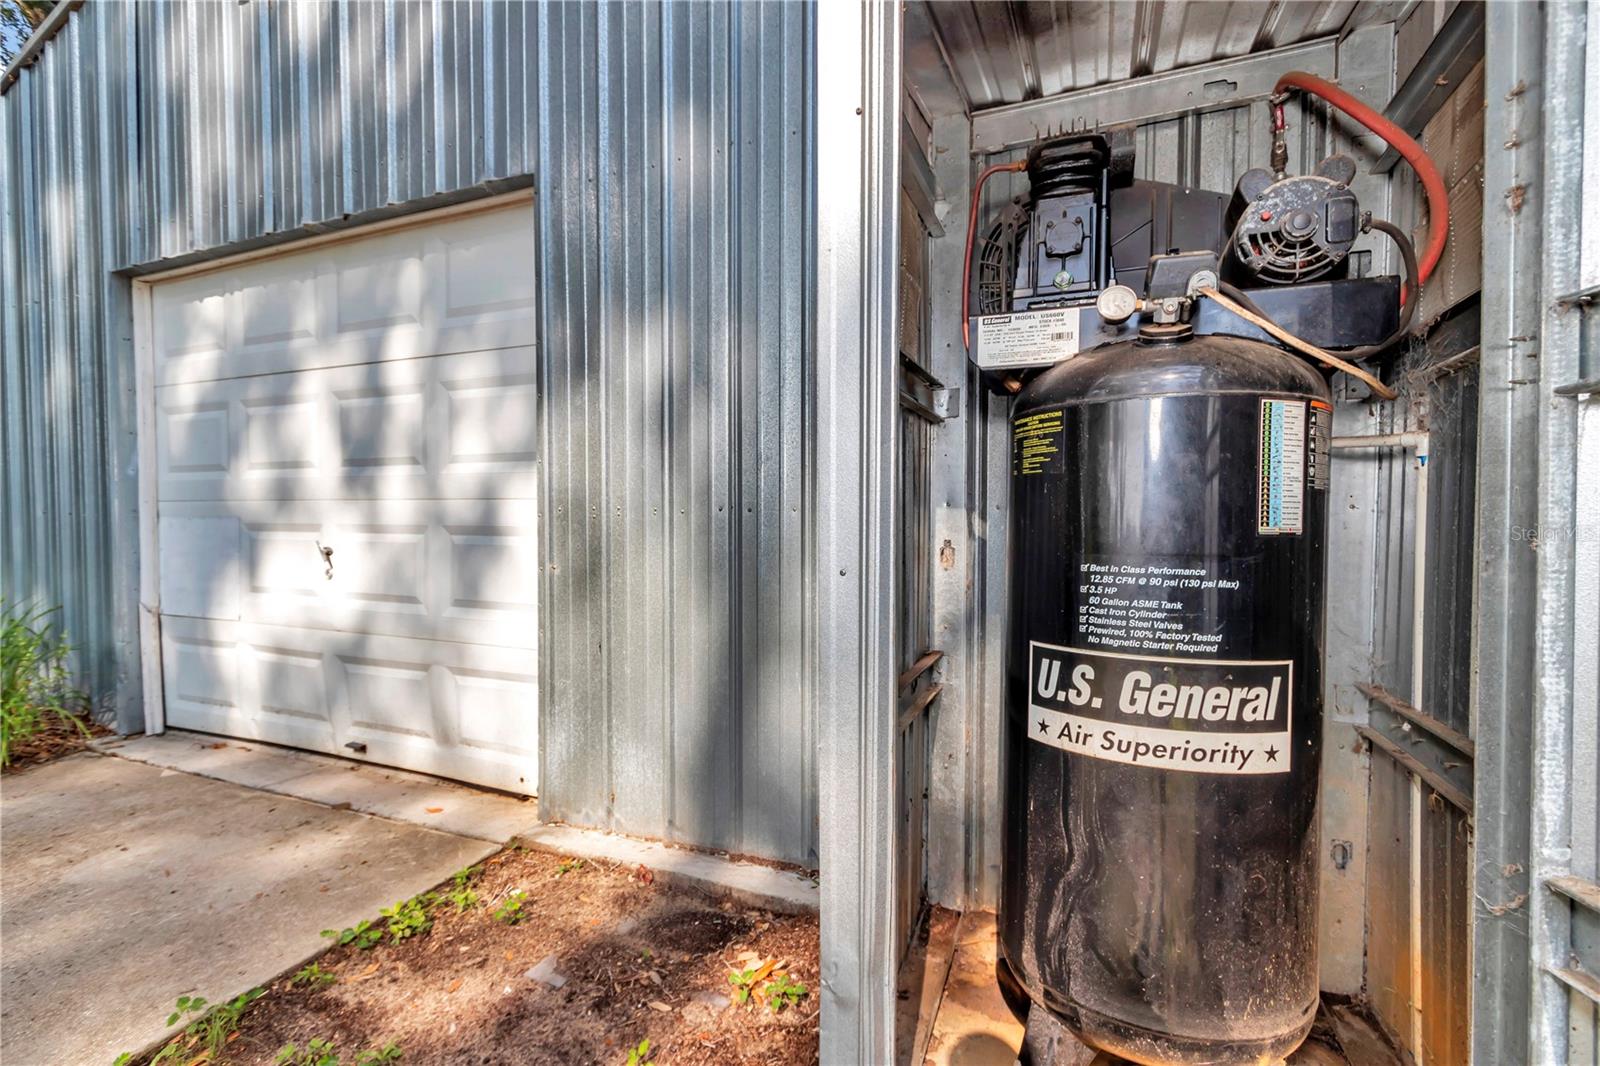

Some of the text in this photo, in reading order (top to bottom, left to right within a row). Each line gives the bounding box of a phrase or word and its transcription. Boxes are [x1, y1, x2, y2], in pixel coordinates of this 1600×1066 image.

[1090, 564, 1109, 572] Best
[1121, 566, 1145, 574] Class
[1148, 567, 1206, 576] Performance
[1090, 575, 1113, 583] 12.85
[1150, 578, 1161, 586] 90
[1164, 579, 1178, 587] psi
[1180, 579, 1199, 588] (130
[1201, 580, 1215, 588] psi
[1218, 581, 1239, 589] Max)
[1102, 598, 1129, 606] Gallon
[1131, 600, 1159, 608] ASME
[1161, 601, 1183, 610] Tank
[1110, 608, 1126, 616] Iron
[1128, 610, 1167, 619] Cylinder
[1089, 616, 1183, 630] Stainless Steel Valves
[1089, 626, 1222, 642] Prewired, 100% Factory Tested
[1101, 637, 1140, 648] Magnetic
[1143, 641, 1174, 650] Starter
[1176, 643, 1217, 652] Required
[1038, 658, 1281, 722] U.S. General
[1057, 722, 1254, 770] Air Superiority
